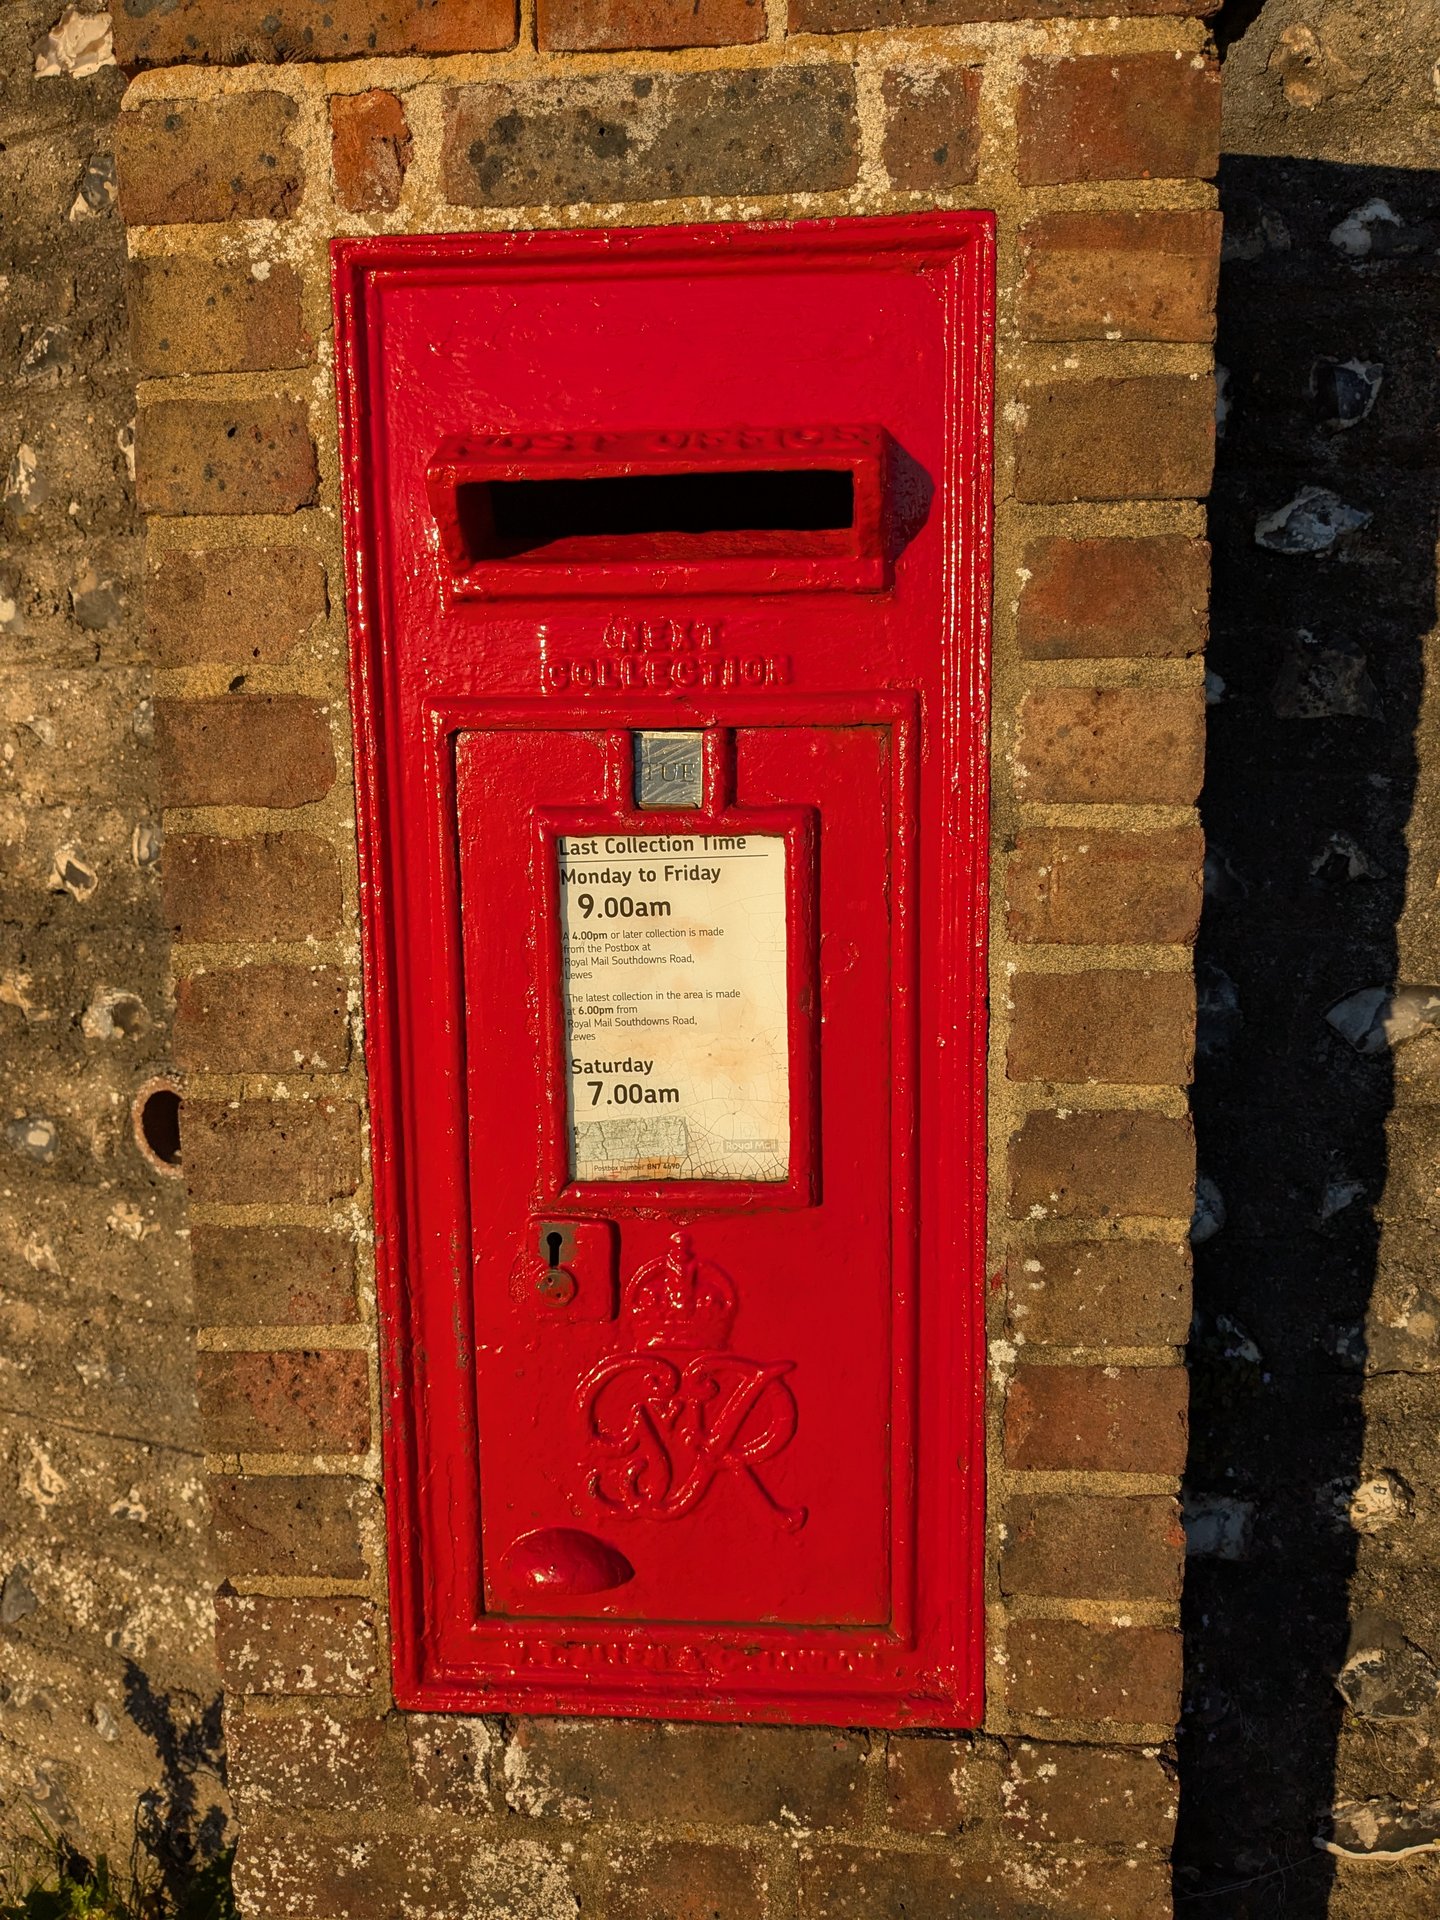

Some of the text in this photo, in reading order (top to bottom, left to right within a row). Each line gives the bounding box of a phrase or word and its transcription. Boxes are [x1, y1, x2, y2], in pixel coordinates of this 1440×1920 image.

[603, 615, 725, 650] NEXT
[547, 655, 794, 690] COLLECTION
[642, 761, 695, 783] TUE
[559, 835, 747, 856] Last Collection Time
[561, 865, 721, 887] Monday to Friday
[577, 893, 672, 919] 9.00am
[562, 927, 725, 942] A 4.00pm or later collection is made
[564, 943, 652, 954] from the Postbox at
[564, 954, 695, 968] Royal Mail Southdowns Road,
[565, 970, 593, 980] Lewes
[566, 989, 741, 1003] The latest collection in the area is made
[566, 1005, 638, 1017] at 6.00pm from
[568, 1016, 698, 1030] Royal Mail Southdowns Road,
[568, 1032, 596, 1042] Lewes
[571, 1057, 654, 1076] Saturday
[587, 1081, 680, 1106] 7.00am
[725, 1140, 753, 1152] Royal
